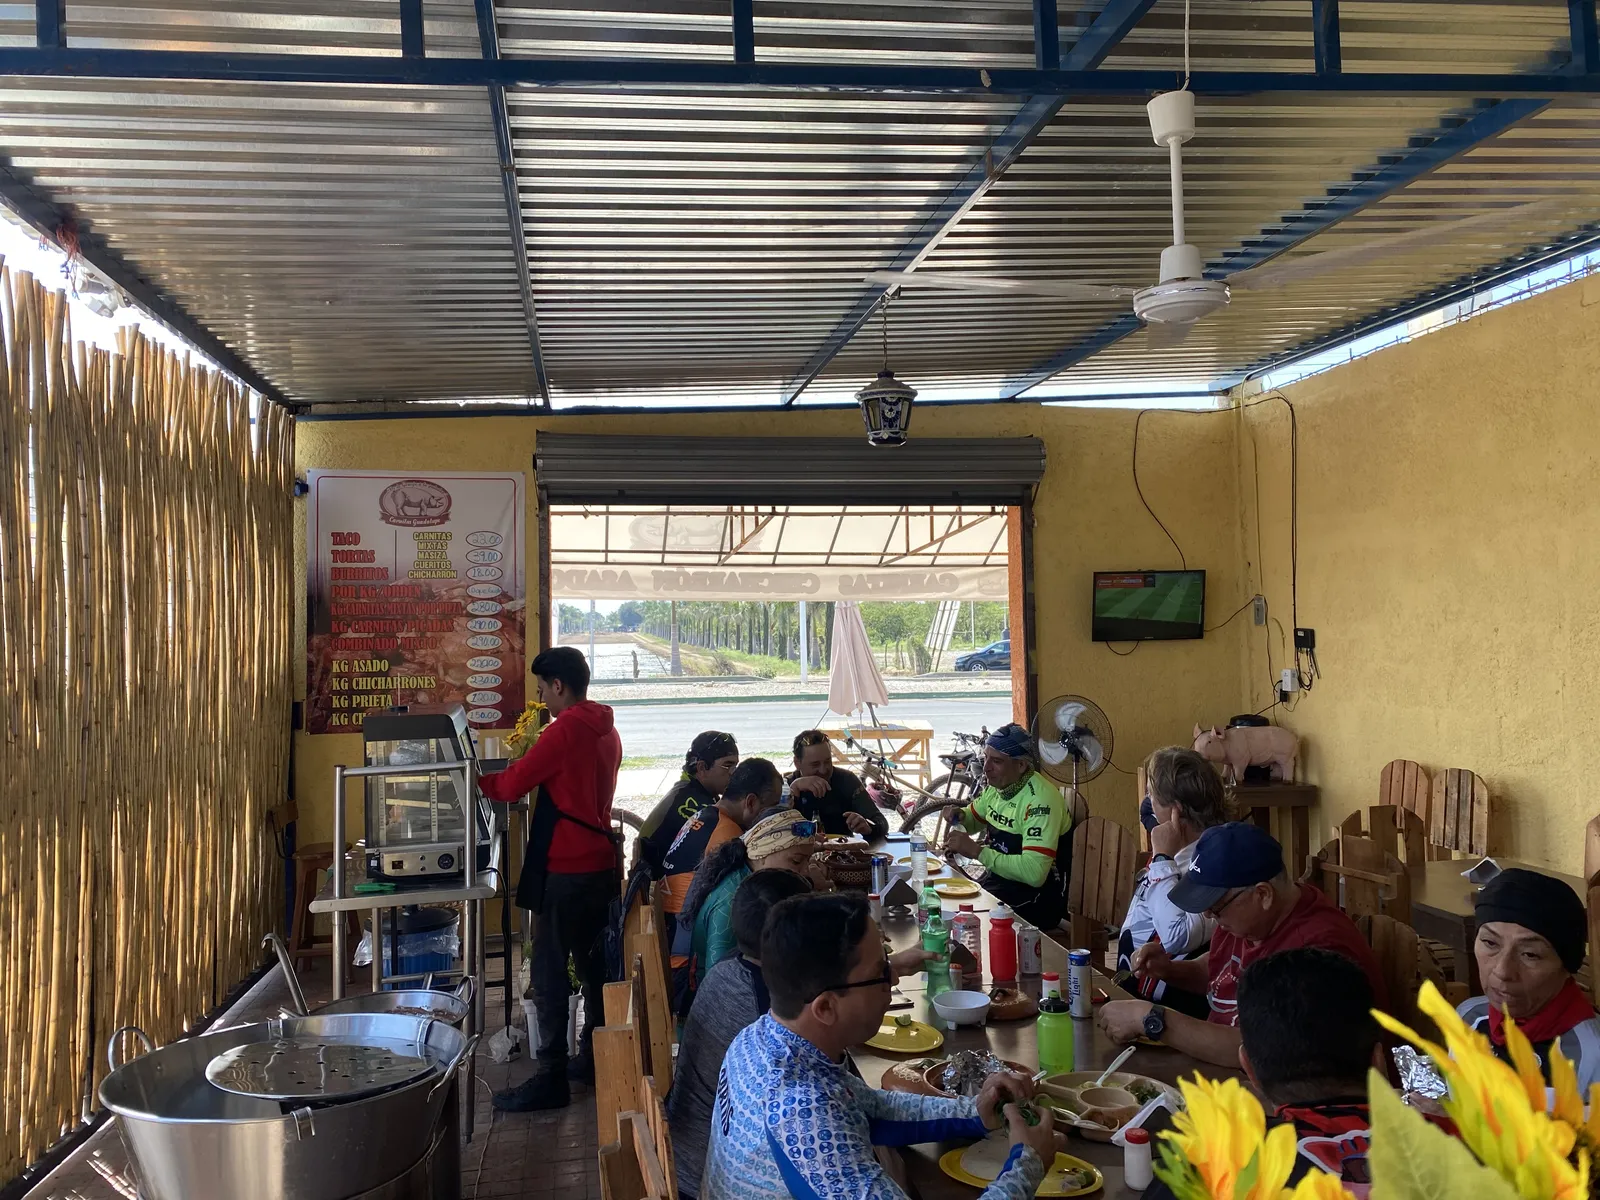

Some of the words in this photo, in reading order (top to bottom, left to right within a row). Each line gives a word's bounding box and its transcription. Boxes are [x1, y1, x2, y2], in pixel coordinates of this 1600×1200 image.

[331, 531, 360, 546] TACO
[413, 532, 452, 541] CARNITAS
[417, 541, 448, 550] MIXTAS
[331, 550, 376, 563] TORTAS
[417, 551, 448, 560] MASIZA
[413, 560, 452, 569] CUERITOS
[331, 567, 388, 581] BURRITOS
[408, 570, 458, 579] CHICHARRON
[331, 584, 356, 598] POR
[343, 602, 385, 616] CARNITAS
[386, 602, 416, 616] MIXTAS
[331, 619, 348, 633] KG
[350, 619, 403, 633] CARNITAS
[406, 618, 455, 633] PICADAS
[331, 636, 398, 651] COMBINADO
[400, 636, 437, 651] MIXTO
[332, 660, 349, 673] KG
[352, 659, 389, 672] ASADO
[332, 677, 349, 690] KG
[352, 676, 437, 690] CHICHARRONES
[332, 695, 349, 708] KG
[352, 694, 393, 708] PRIETA
[332, 713, 349, 726] KG
